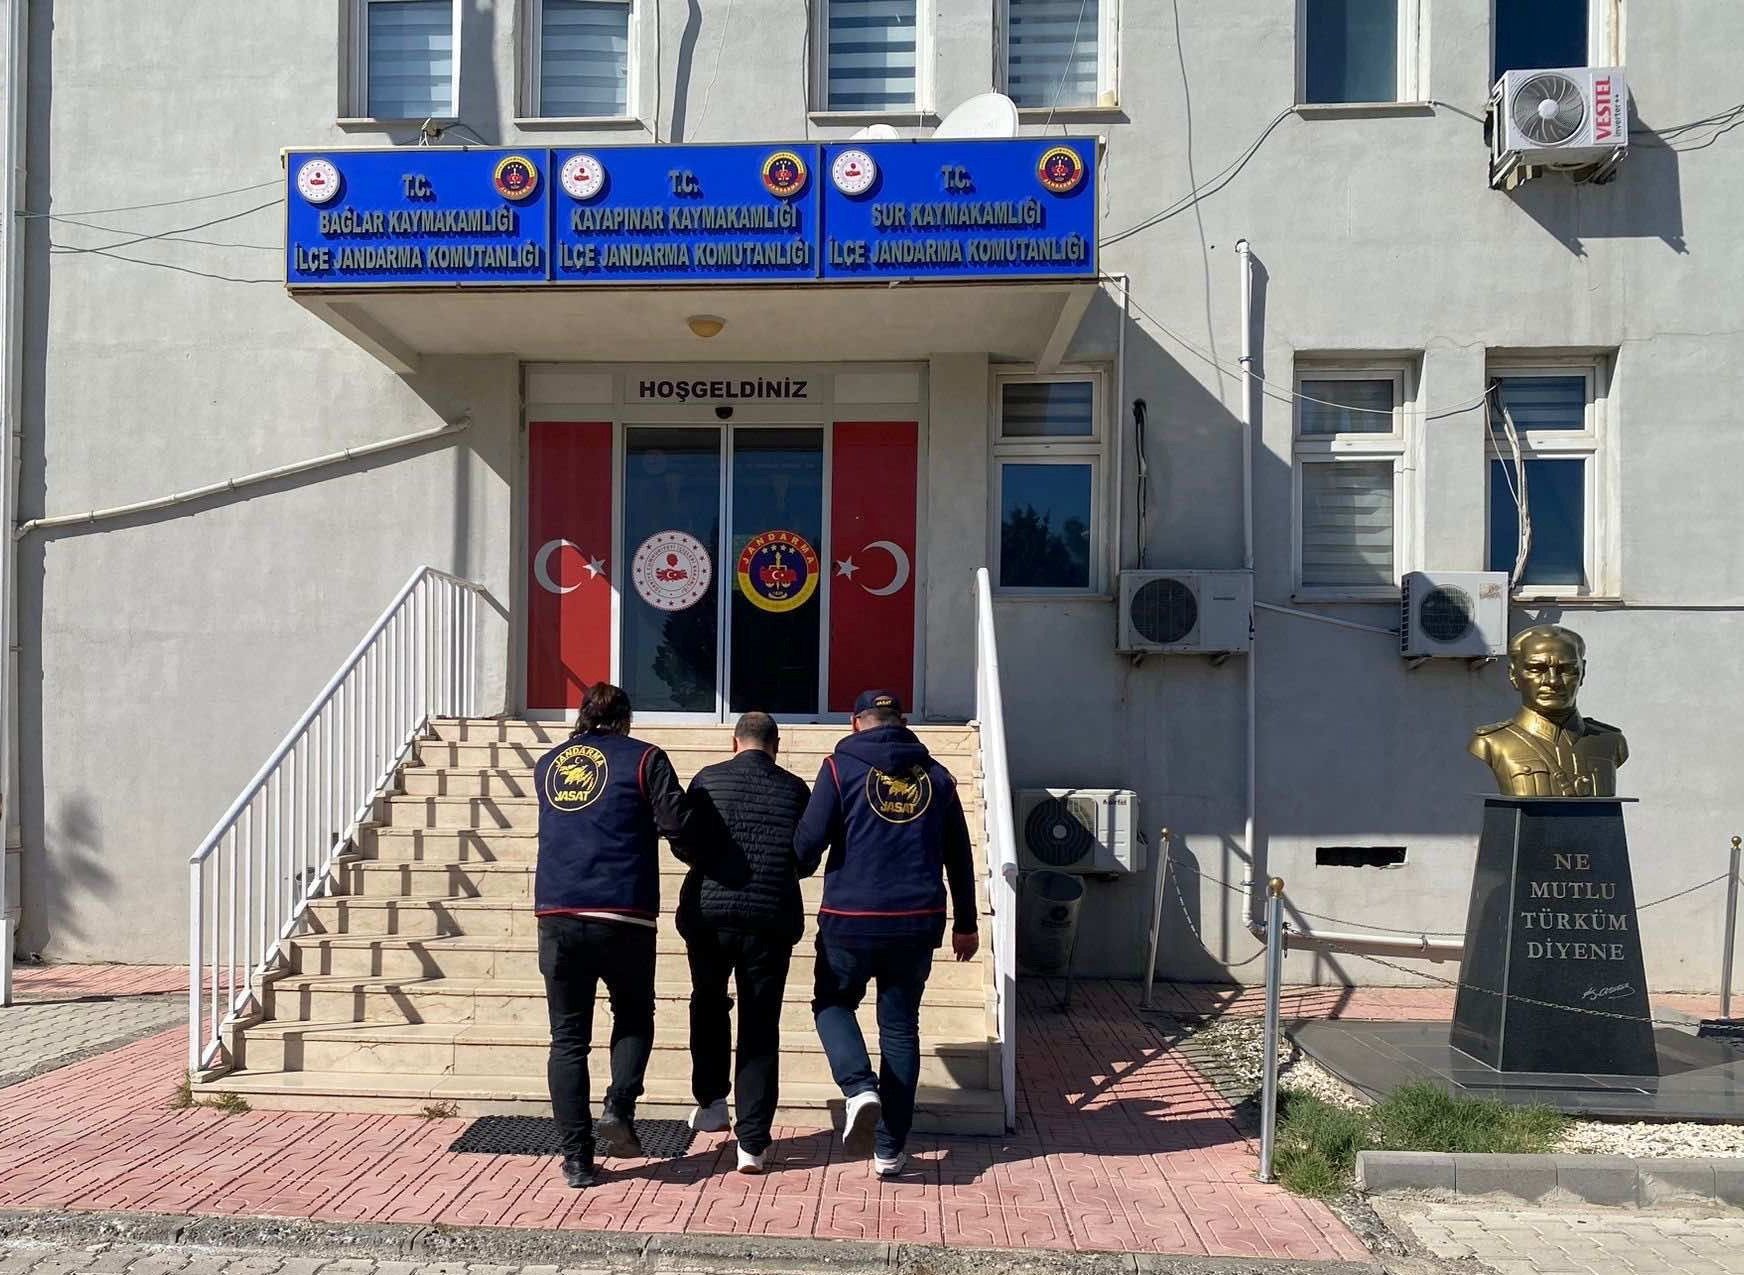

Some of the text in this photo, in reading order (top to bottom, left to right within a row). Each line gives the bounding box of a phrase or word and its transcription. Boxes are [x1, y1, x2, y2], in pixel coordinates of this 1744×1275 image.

[1595, 75, 1611, 140] VESTEL
[403, 174, 431, 196] T.C.
[670, 170, 700, 192] T.C.
[942, 165, 971, 188] T.C.
[320, 204, 513, 233] BAĞLAR KAYMAKAMLIĞI
[571, 200, 796, 230] KAYAPINAR KAYMAKAMLIĞI
[872, 196, 1041, 226] SUR KAYMAKAMLIĞI
[295, 240, 539, 271] İLÇE JANDARMA KOMUTANLIĞI
[560, 236, 809, 269] İLÇE JANDARMA KOMUTANLIĞI
[828, 231, 1084, 266] İLÇE JANDARMA KOMUTANLIĞI
[639, 377, 808, 402] HOŞGELDİNİZ
[742, 532, 814, 565] JANDARMA
[555, 746, 605, 769] JANDARMA
[555, 790, 590, 801] JASAT
[880, 801, 916, 814] JASAT
[1554, 853, 1592, 870] NE
[1530, 881, 1617, 899] MUTLU
[1521, 908, 1628, 931] TÜRKÜM
[1527, 938, 1625, 960] DİYENE
